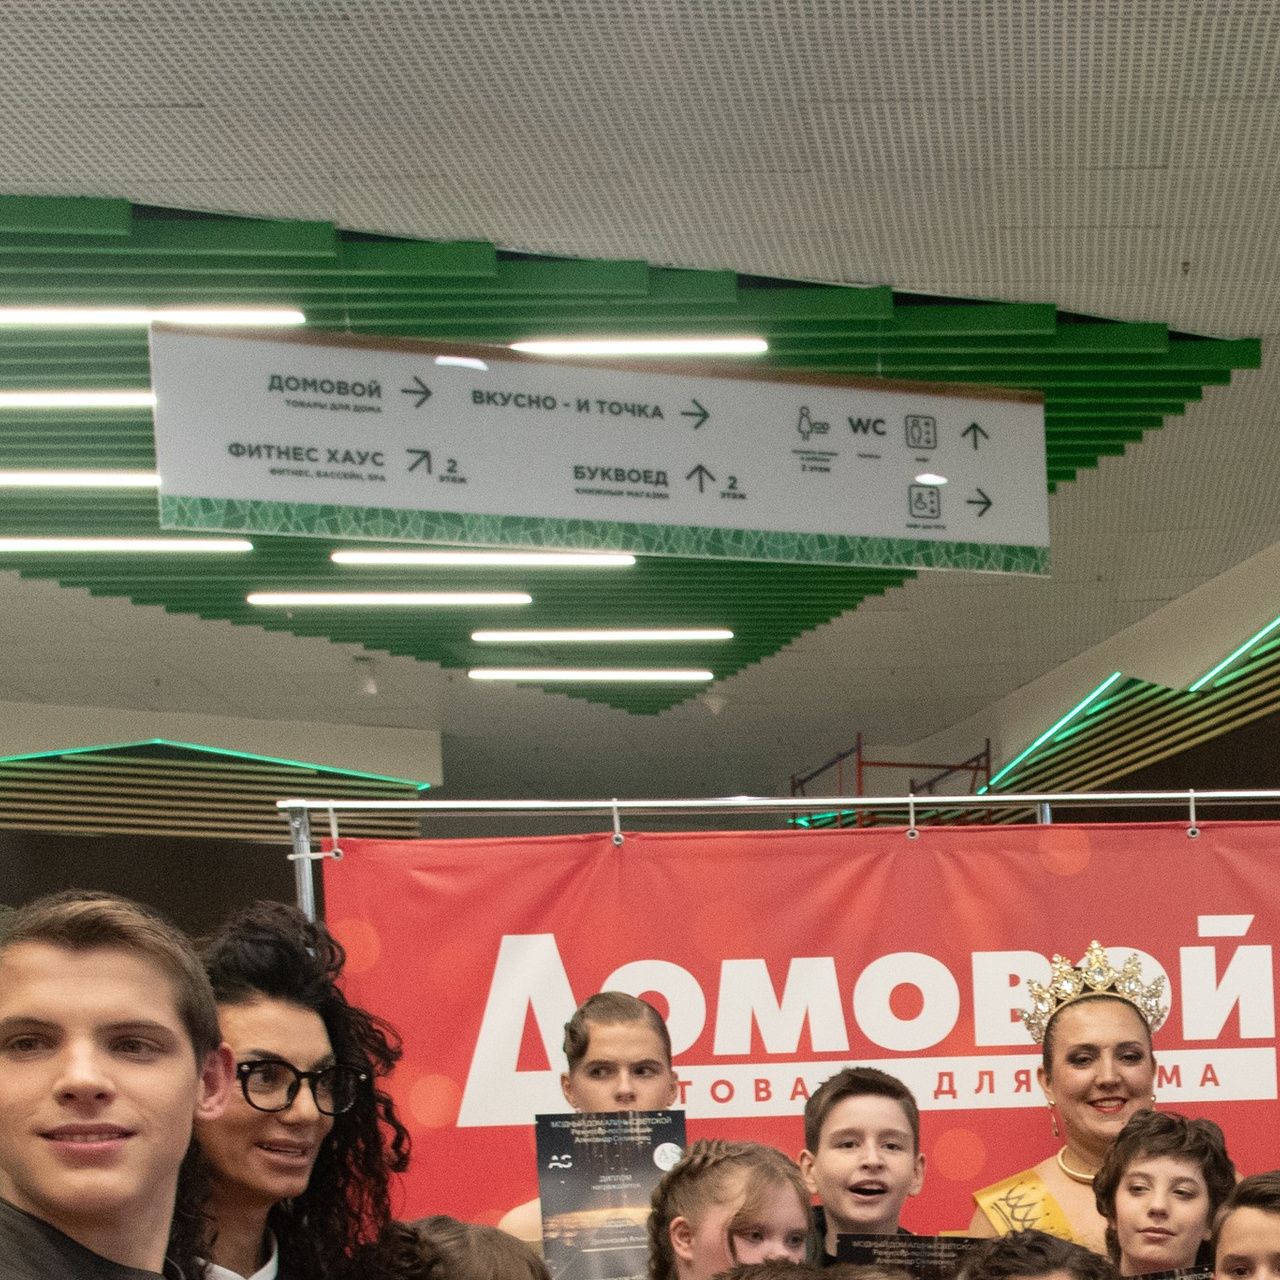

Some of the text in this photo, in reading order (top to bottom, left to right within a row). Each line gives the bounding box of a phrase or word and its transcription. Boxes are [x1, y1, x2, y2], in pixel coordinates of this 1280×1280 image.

[268, 374, 382, 398] ДОМОВОЙ
[471, 390, 557, 410] ВКУСНО
[577, 399, 590, 413] И
[596, 400, 664, 419] ТОЧКА
[849, 417, 886, 435] WC
[228, 442, 384, 467] ФИТНЕС ХАУС
[447, 458, 457, 473] 2
[573, 465, 668, 487] БУКВОЕД
[728, 475, 738, 490] 2
[933, 1070, 1031, 1100] ДЛЯ
